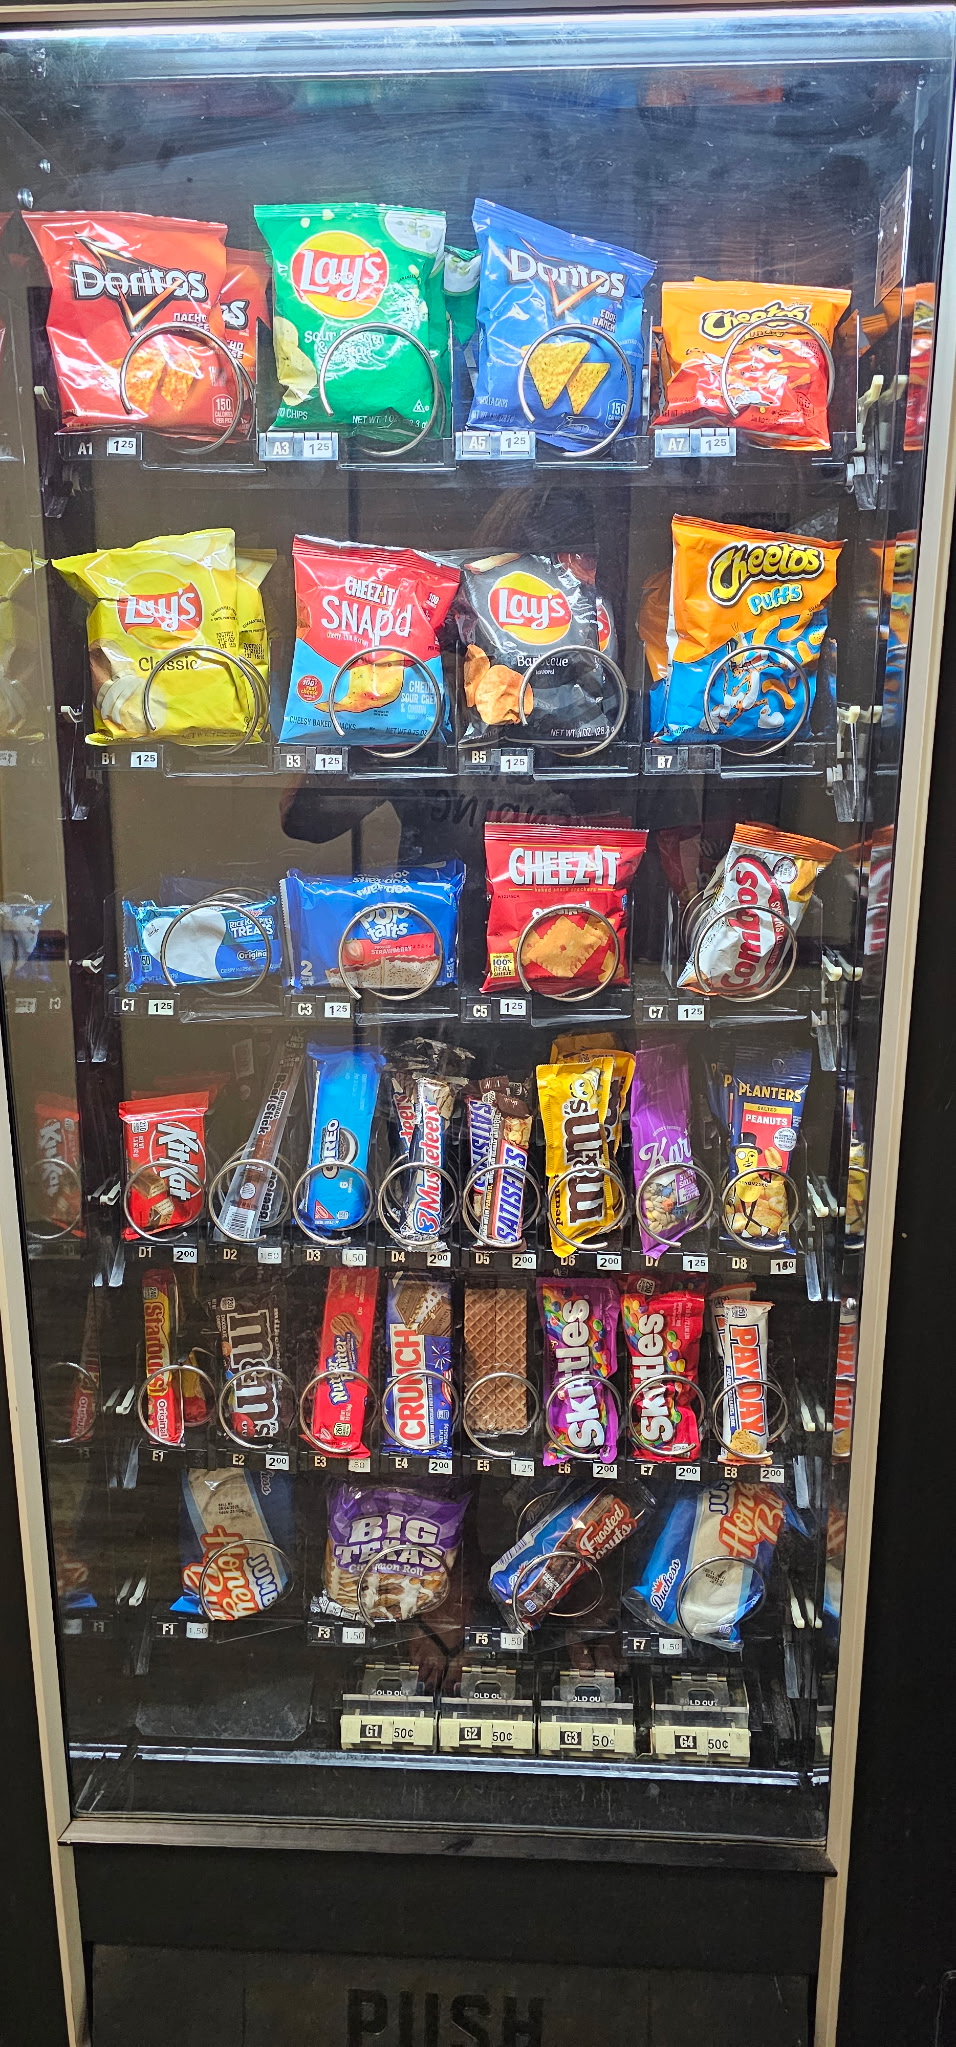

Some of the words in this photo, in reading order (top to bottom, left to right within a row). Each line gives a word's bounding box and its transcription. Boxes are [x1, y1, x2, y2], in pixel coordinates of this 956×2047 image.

[299, 249, 384, 301] Lay's
[508, 248, 625, 298] Doritos
[73, 262, 208, 299] Doritos
[173, 312, 207, 323] NACHO
[600, 308, 616, 322] COOL
[591, 316, 616, 332] RANCH
[304, 330, 337, 343] Sour
[215, 398, 232, 411] 150
[286, 408, 308, 420] CHIPS
[352, 415, 367, 424] NET
[77, 441, 93, 455] A1
[272, 441, 290, 455] A3
[468, 436, 486, 449] A5
[667, 438, 685, 451] A7
[711, 542, 822, 600] Cheetos
[748, 584, 803, 615] Puffs
[124, 588, 197, 632] Lay's
[499, 589, 566, 630] Lay's
[138, 655, 199, 672] Classic
[517, 655, 569, 667] Barecue
[289, 715, 312, 726] CHEESY
[312, 718, 332, 728] BAKED
[101, 752, 116, 765] B1
[286, 755, 301, 768] B3
[471, 750, 487, 763] B5
[657, 755, 672, 769] B7
[229, 919, 244, 929] RICE
[720, 870, 762, 989] Combos
[231, 925, 274, 938] TREAS
[238, 950, 268, 961] Origina
[301, 960, 313, 976] 2
[493, 965, 512, 973] REAL
[121, 999, 135, 1011] C1
[297, 1003, 313, 1016] C3
[472, 1005, 488, 1018] C5
[648, 1006, 664, 1019] C7
[738, 1083, 803, 1103] PLANTERS
[745, 1113, 788, 1126] PEANUTS
[139, 1120, 147, 1133] 210
[322, 1119, 340, 1179] OREO
[551, 1173, 563, 1226] peant
[418, 1211, 440, 1234] 3
[138, 1247, 152, 1258] D1
[223, 1248, 237, 1260] D2
[306, 1250, 321, 1262] D3
[391, 1251, 406, 1263] D4
[475, 1253, 490, 1265] D5
[560, 1254, 576, 1266] D6
[731, 1257, 748, 1270] D8
[555, 1299, 605, 1448] Skittles
[632, 1313, 674, 1442] Skittles
[730, 1325, 766, 1434] PAYDAY
[393, 1329, 427, 1441] CRUNCH
[156, 1399, 168, 1439] Original
[232, 1454, 245, 1466] E2
[314, 1456, 327, 1468] E3
[395, 1457, 409, 1469] E4
[476, 1460, 490, 1472] E5
[513, 1463, 533, 1474] 1.25
[557, 1463, 571, 1474] E6
[640, 1463, 654, 1476] E7
[724, 1466, 738, 1478] E8
[349, 1513, 439, 1545] BIG
[579, 1503, 625, 1553] Frosted
[335, 1539, 442, 1568] TEXAS
[402, 1564, 424, 1577] Roll
[651, 1558, 681, 1611] Duchess
[162, 1623, 174, 1635] F1
[189, 1626, 208, 1635] 1.50
[317, 1627, 331, 1638] F3
[345, 1630, 365, 1640] 1.50
[475, 1633, 489, 1645] F5
[503, 1636, 522, 1646] 1.50
[633, 1639, 646, 1650] F7
[365, 1725, 379, 1737] G1
[393, 1727, 414, 1739] 50¢
[464, 1727, 478, 1740] G2
[492, 1731, 513, 1742] 50¢
[564, 1732, 579, 1744] G3
[679, 1735, 694, 1748] G4
[707, 1738, 729, 1750] 50¢
[346, 1988, 546, 2047] PUSH
